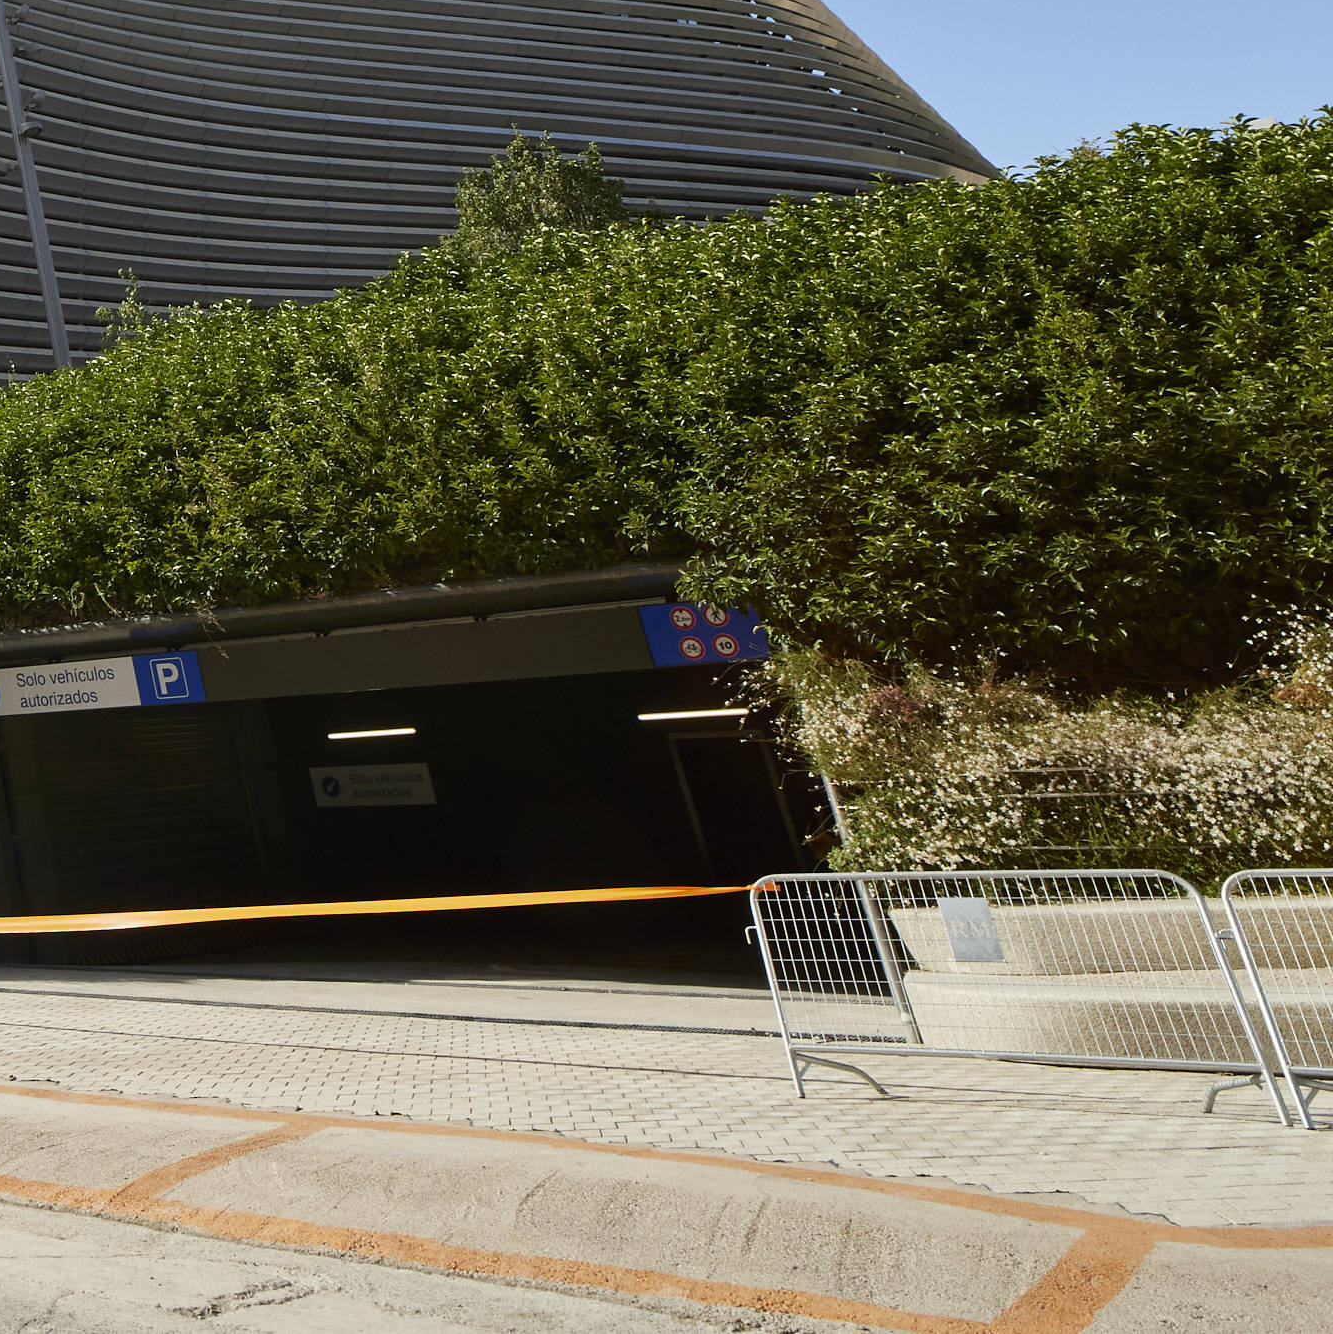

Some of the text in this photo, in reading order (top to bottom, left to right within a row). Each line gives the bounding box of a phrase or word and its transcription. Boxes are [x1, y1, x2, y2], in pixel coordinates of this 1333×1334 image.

[719, 641, 732, 650] 10
[16, 666, 115, 688] Solo vehículos
[156, 663, 179, 695] P
[20, 689, 99, 709] autorizados
